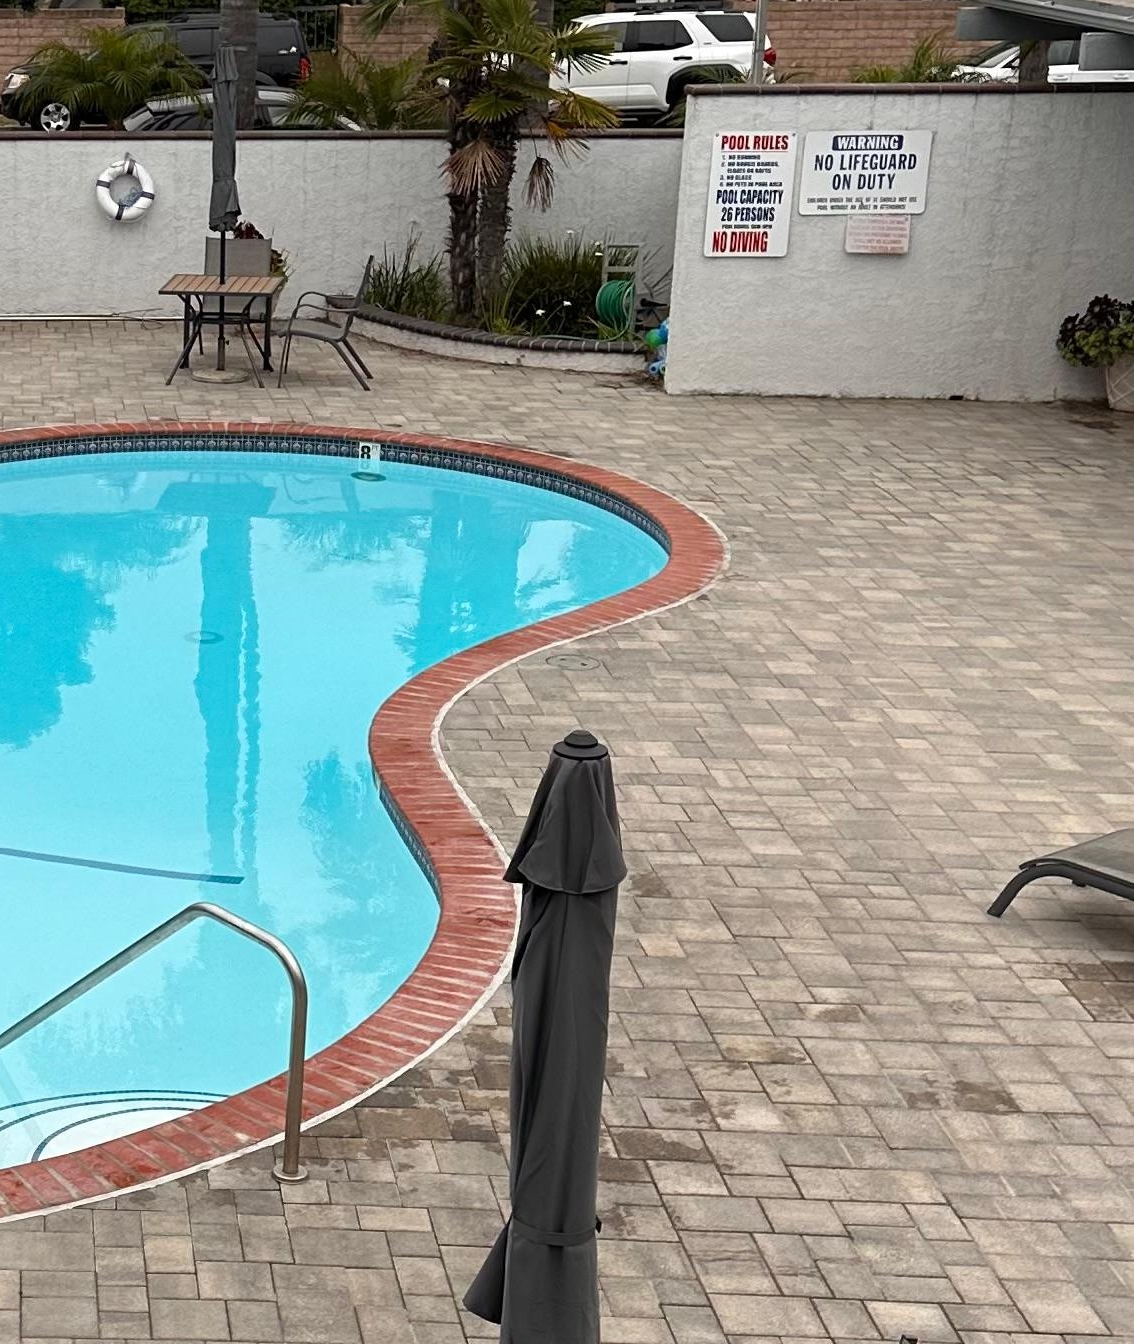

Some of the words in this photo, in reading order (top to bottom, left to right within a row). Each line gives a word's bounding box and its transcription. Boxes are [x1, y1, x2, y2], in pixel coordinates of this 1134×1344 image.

[721, 135, 750, 150] POOL
[753, 135, 789, 150] RULES
[837, 136, 899, 150] WARNING
[814, 154, 834, 171] NO
[839, 154, 917, 171] LIFEGUARD
[832, 173, 852, 190] ON
[857, 173, 896, 190] DUTY
[716, 189, 738, 205] POOL
[739, 189, 784, 205] CAPACITY
[721, 207, 734, 222] 26
[734, 207, 775, 222] PERSONS
[712, 231, 728, 253] NO
[729, 231, 769, 253] DIVING
[361, 445, 371, 460] 8
